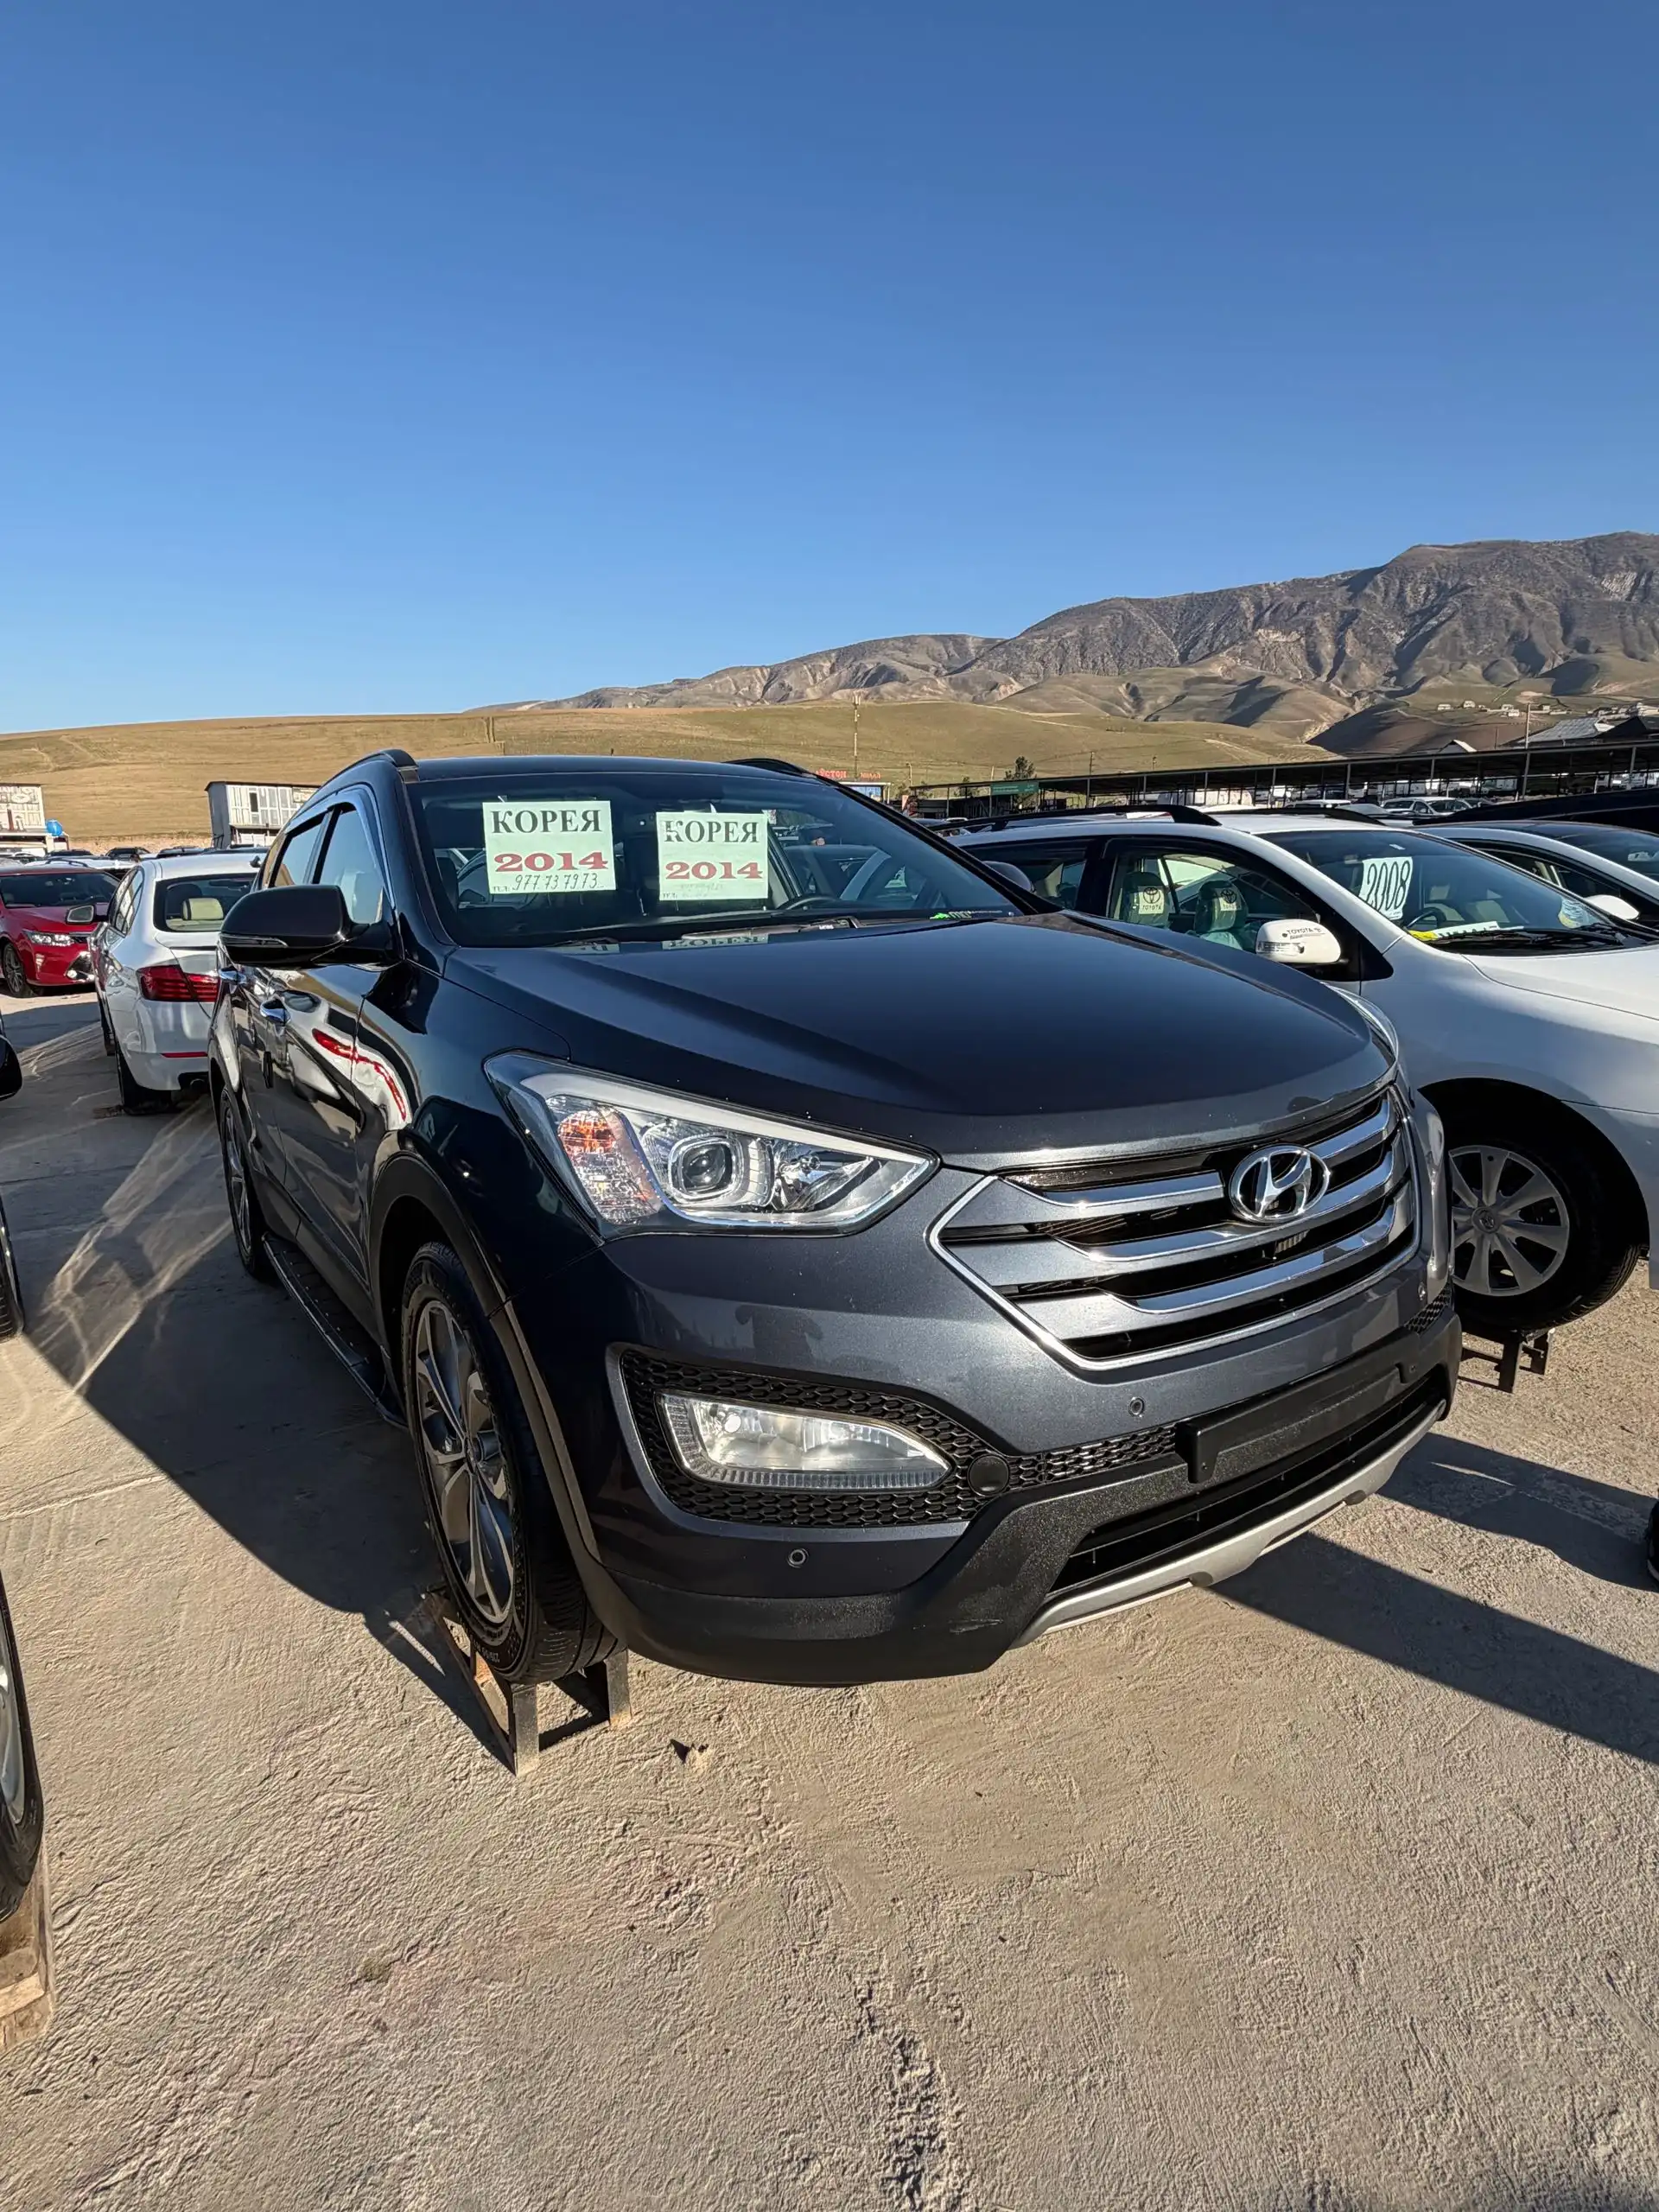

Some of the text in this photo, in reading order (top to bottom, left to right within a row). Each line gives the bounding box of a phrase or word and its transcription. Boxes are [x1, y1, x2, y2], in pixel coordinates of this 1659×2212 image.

[491, 810, 601, 833] КОРЕЯ
[664, 820, 760, 842] КОРЕЯ
[494, 852, 608, 872] 2014
[665, 861, 763, 880] 2014
[1366, 860, 1410, 912] 2008
